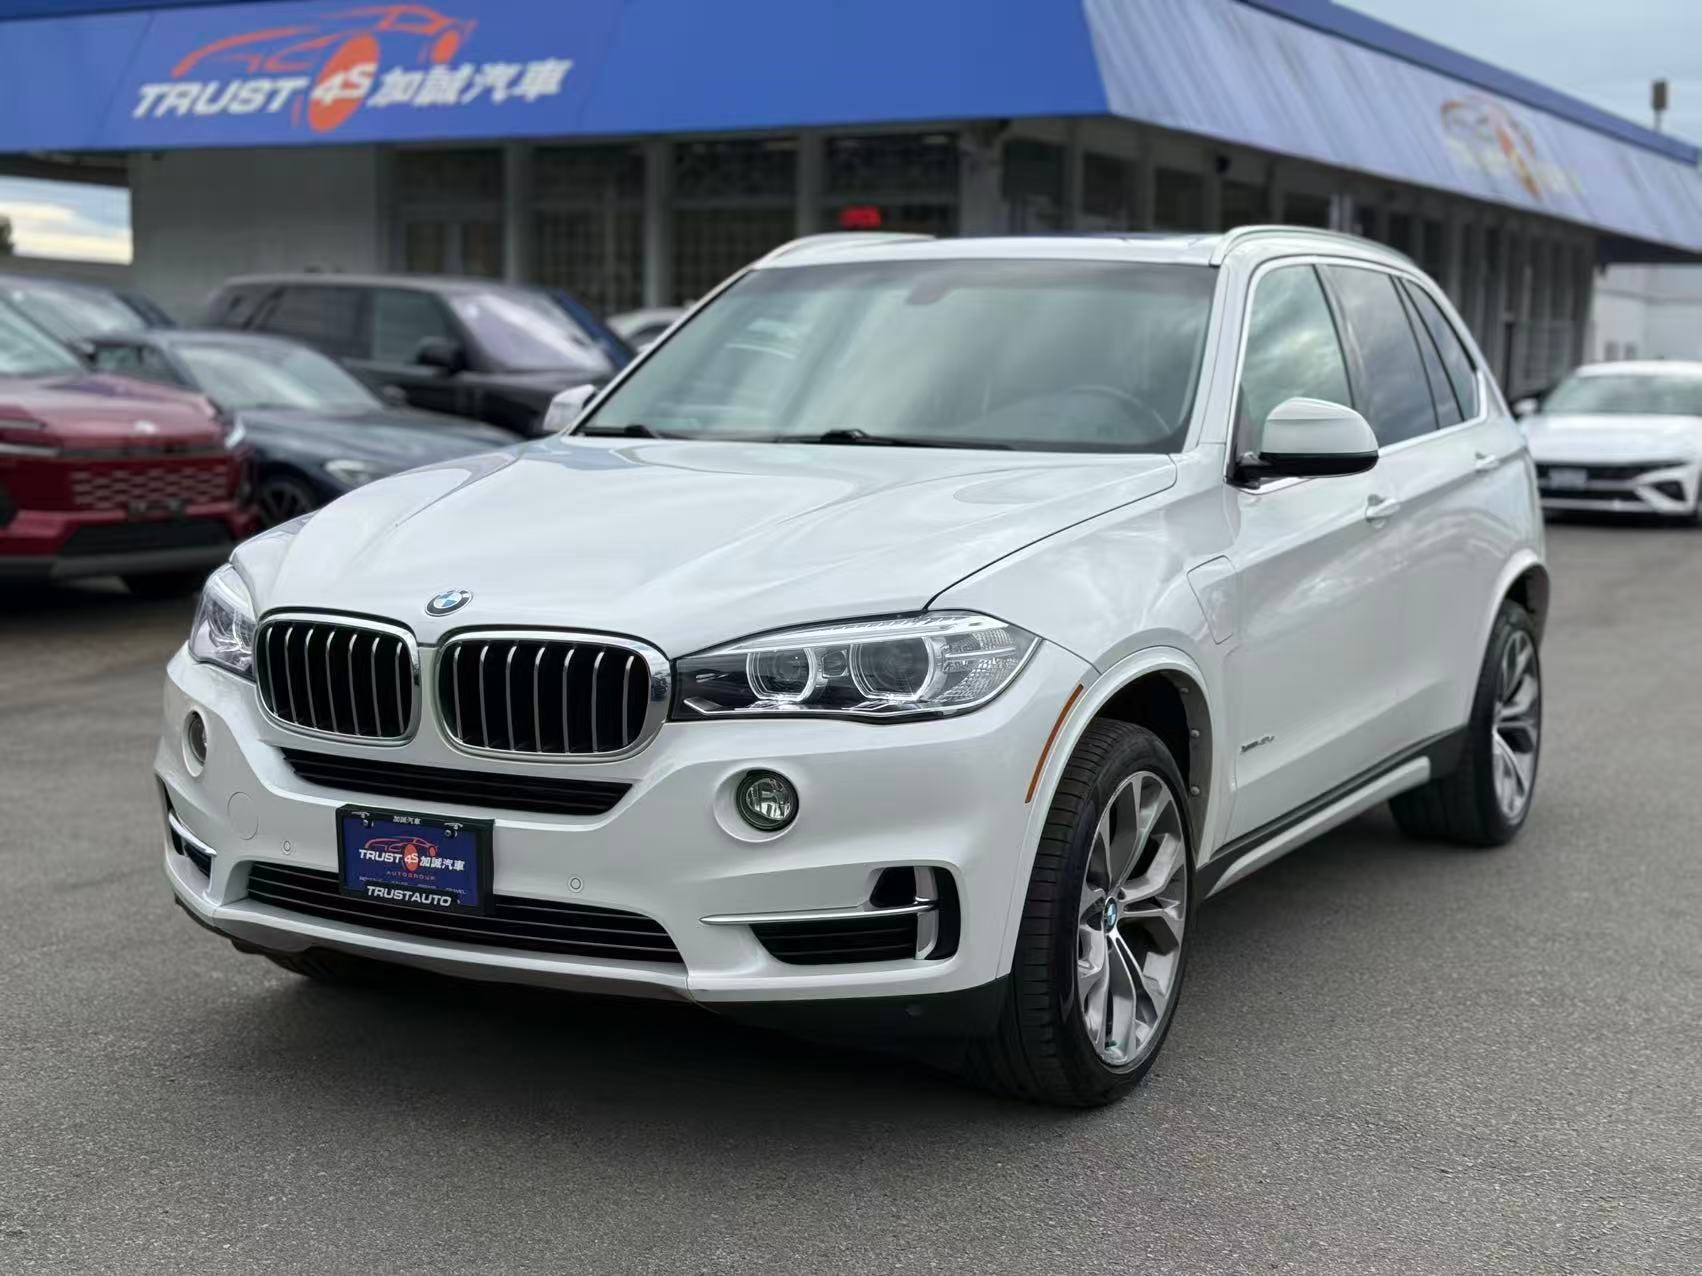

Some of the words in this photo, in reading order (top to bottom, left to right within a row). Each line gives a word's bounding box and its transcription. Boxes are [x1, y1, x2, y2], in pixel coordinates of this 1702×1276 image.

[133, 78, 309, 118] TRUST
[359, 849, 402, 863] TRUST
[404, 853, 418, 864] 4S
[367, 886, 451, 906] TRUSTAUTO
